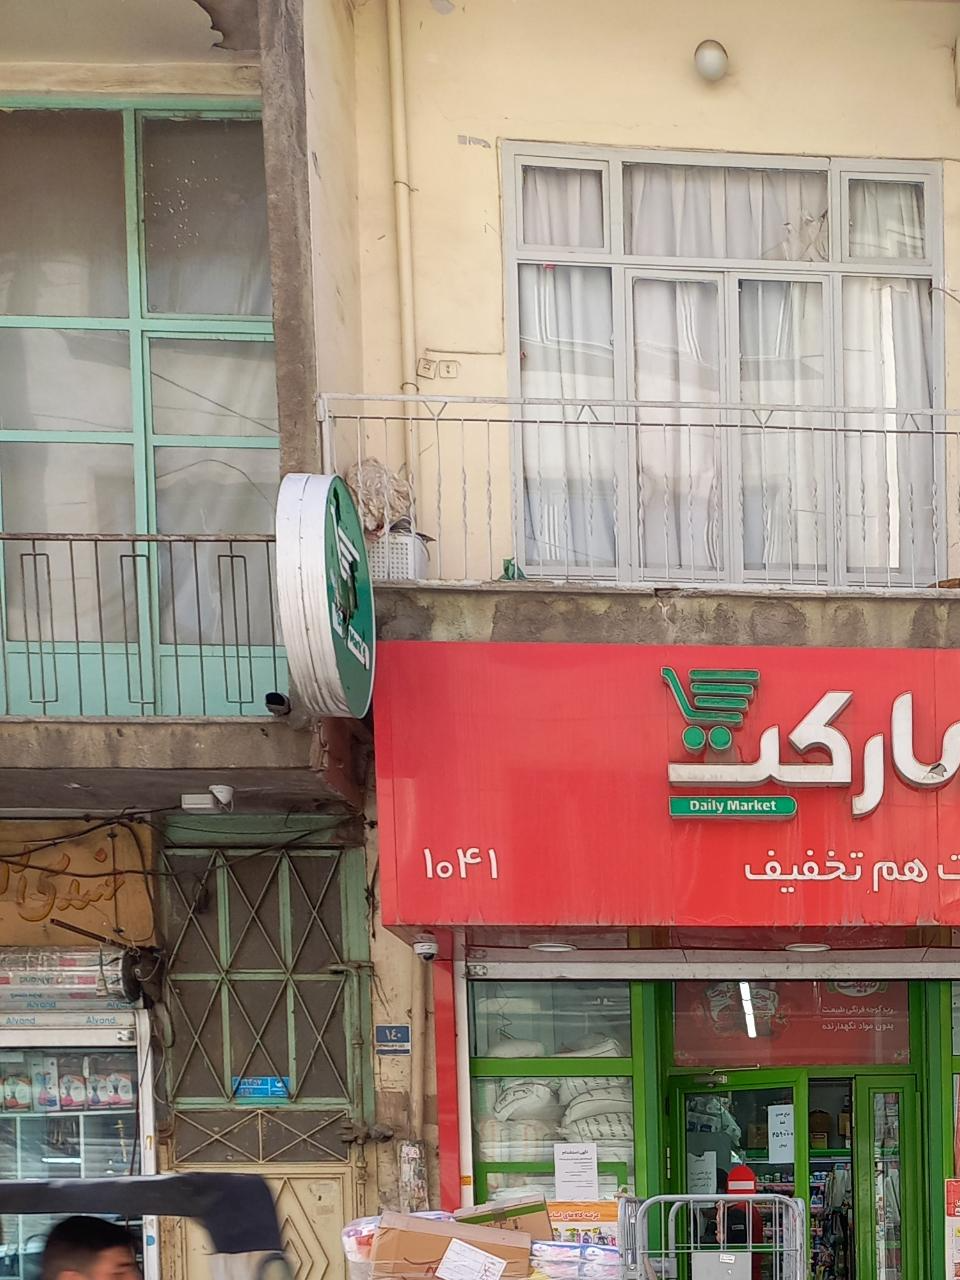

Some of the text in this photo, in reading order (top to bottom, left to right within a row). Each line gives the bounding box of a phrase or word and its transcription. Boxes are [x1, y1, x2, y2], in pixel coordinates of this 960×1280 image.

[689, 798, 776, 815] Daily Market
[743, 848, 862, 893] تخفیف
[873, 858, 928, 893] هم
[6, 1017, 36, 1025] Alvand
[86, 1016, 117, 1025] Alvand
